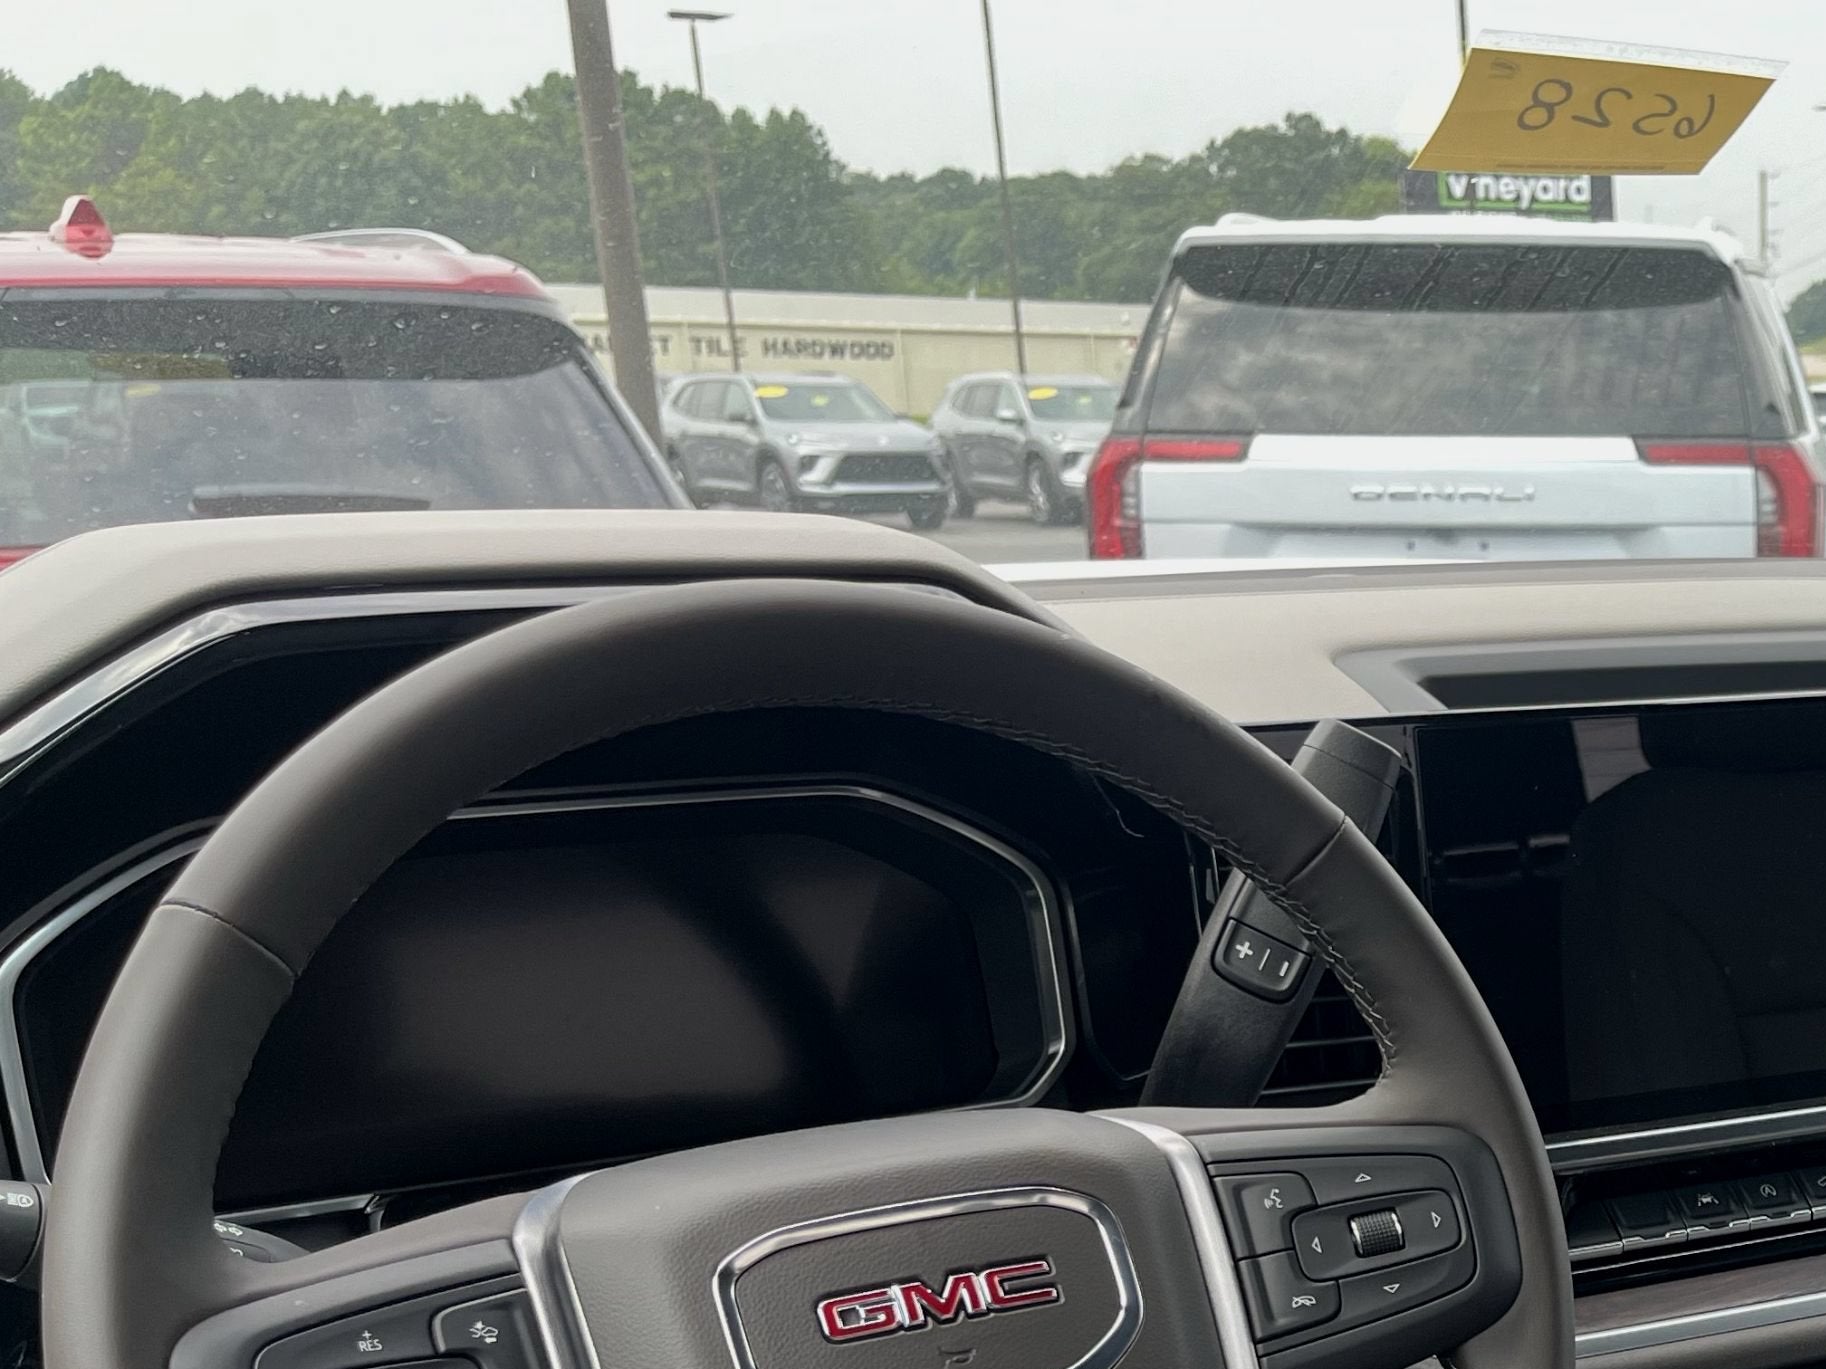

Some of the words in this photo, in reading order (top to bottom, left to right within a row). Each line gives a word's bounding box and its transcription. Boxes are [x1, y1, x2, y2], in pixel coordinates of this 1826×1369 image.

[1446, 174, 1592, 210] vneyard
[761, 335, 895, 361] HARDWOOD
[817, 1259, 1061, 1341] GMC
[358, 1338, 383, 1352] RES
